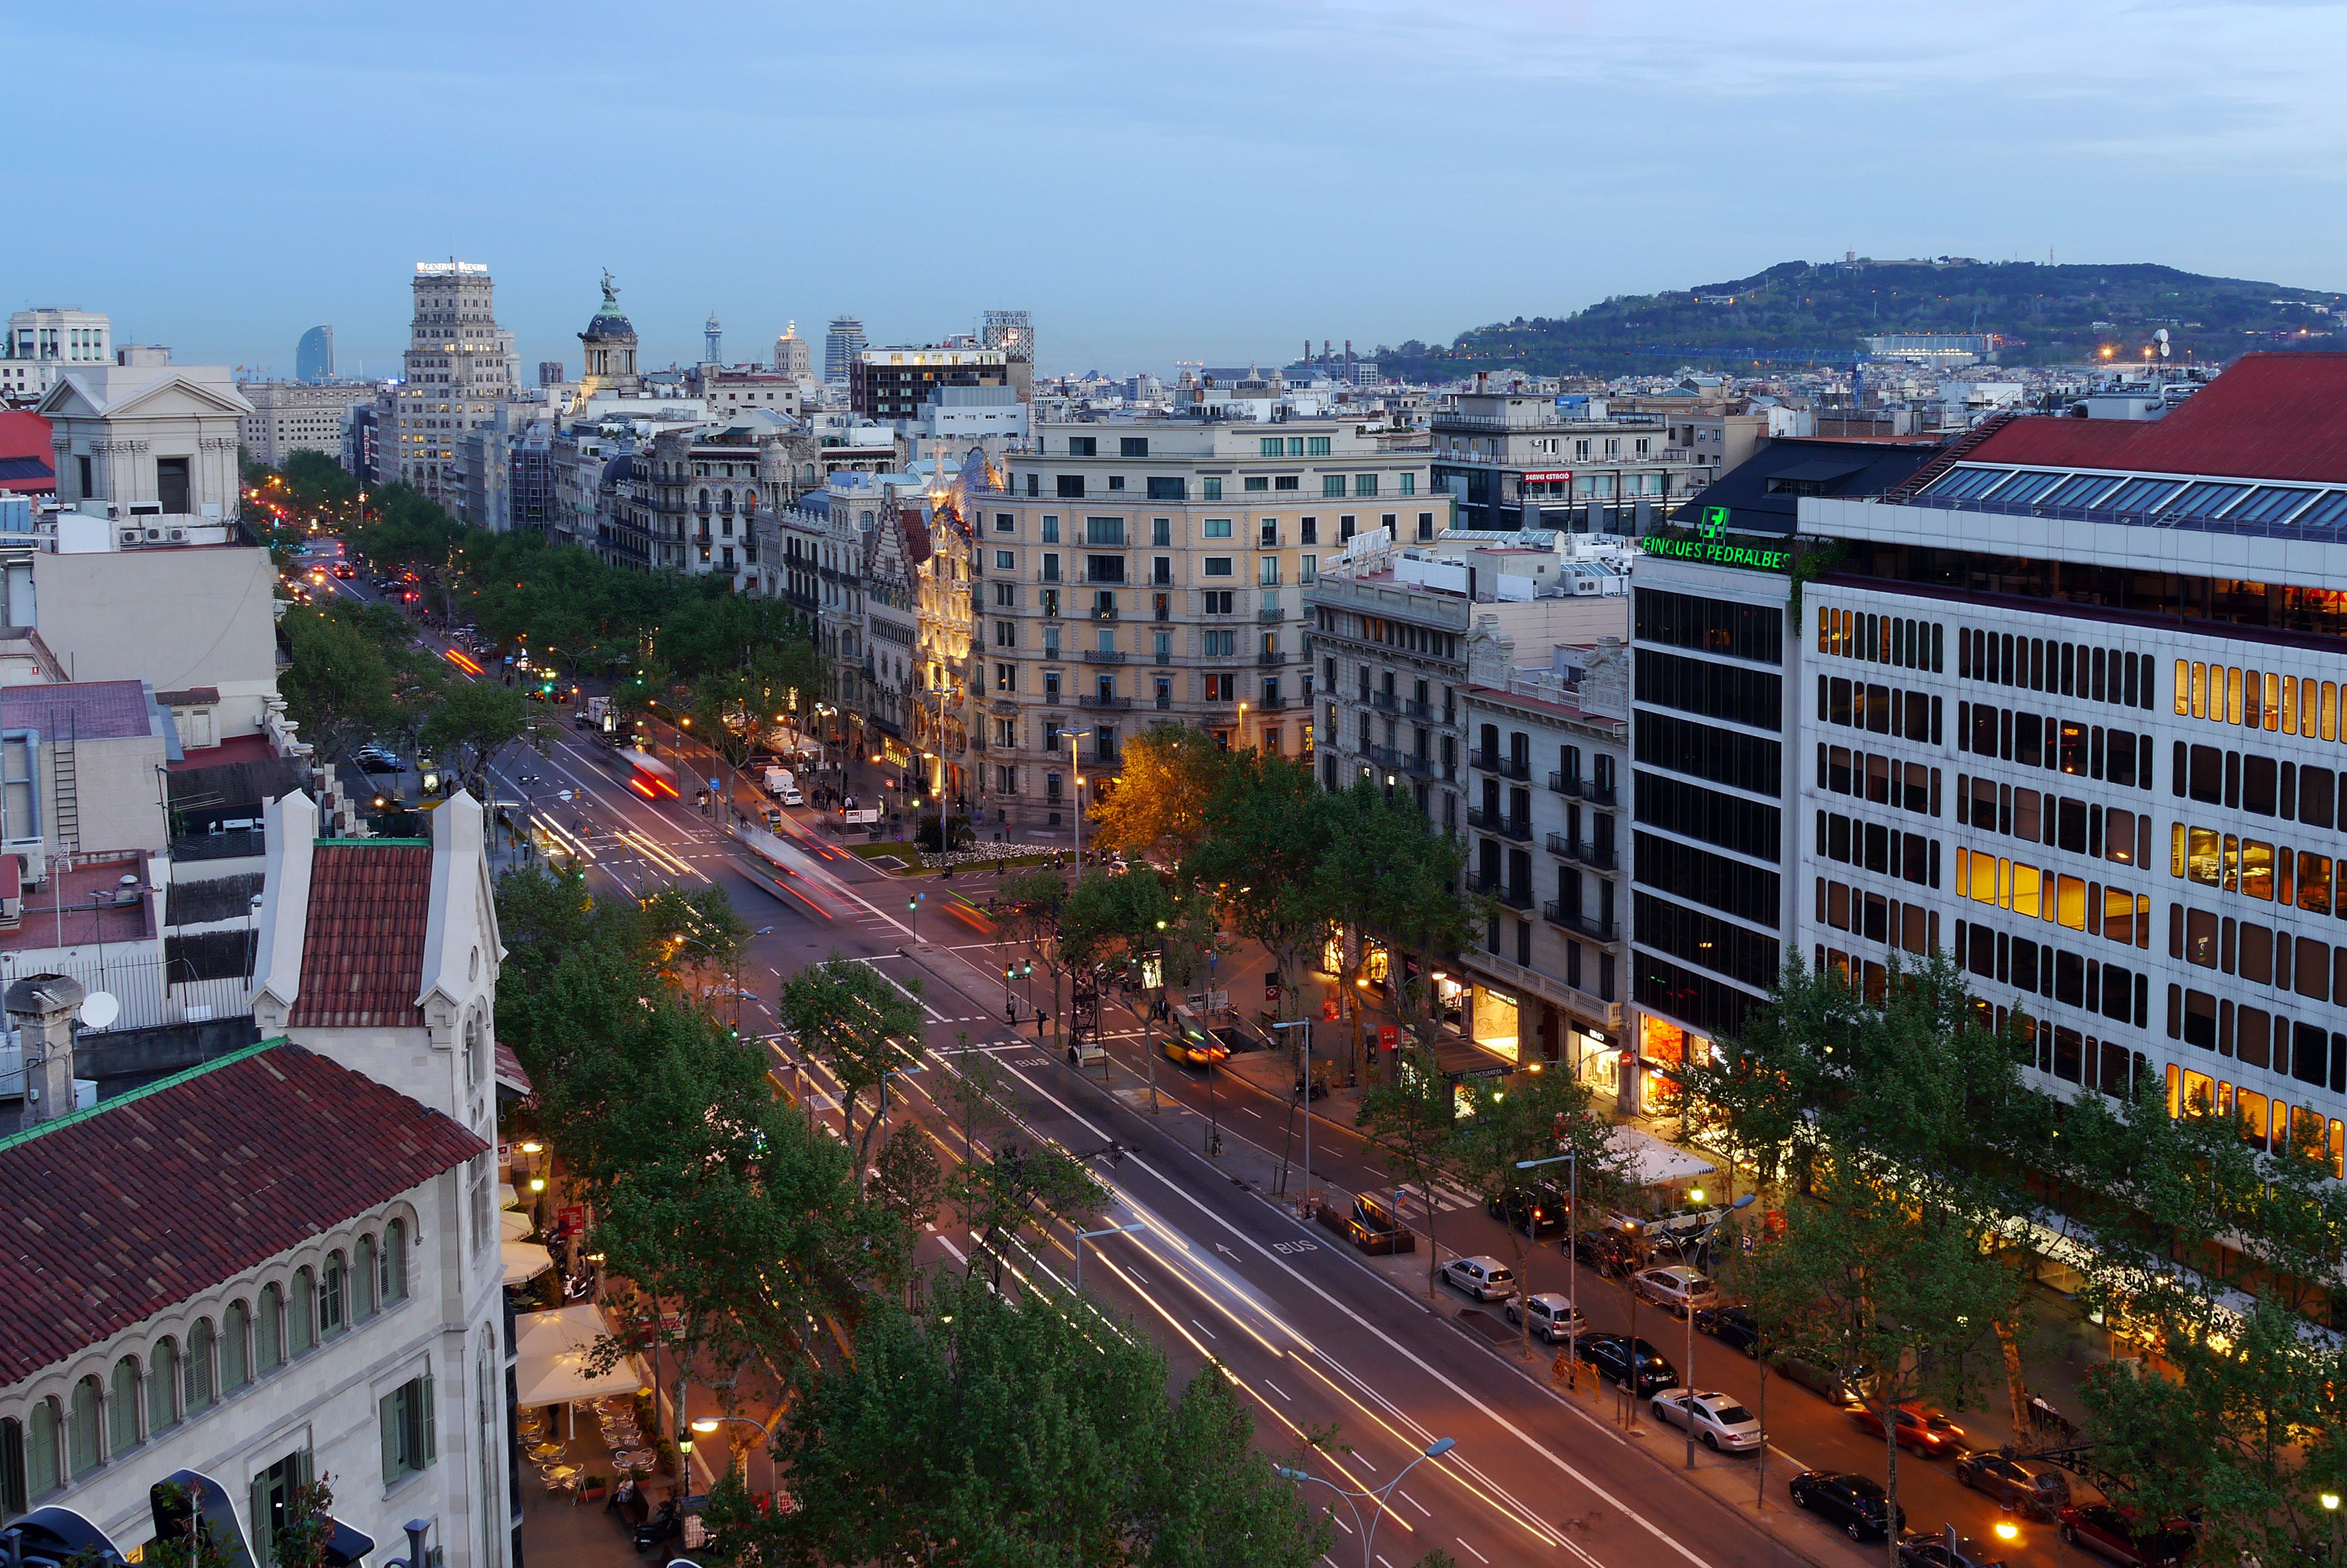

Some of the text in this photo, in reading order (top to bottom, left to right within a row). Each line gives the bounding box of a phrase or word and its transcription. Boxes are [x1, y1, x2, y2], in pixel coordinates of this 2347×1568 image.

[1643, 537, 1791, 568] FINQUES PEDRALBES
[1014, 1058, 1050, 1067] BUS
[1272, 1239, 1318, 1255] BUS
